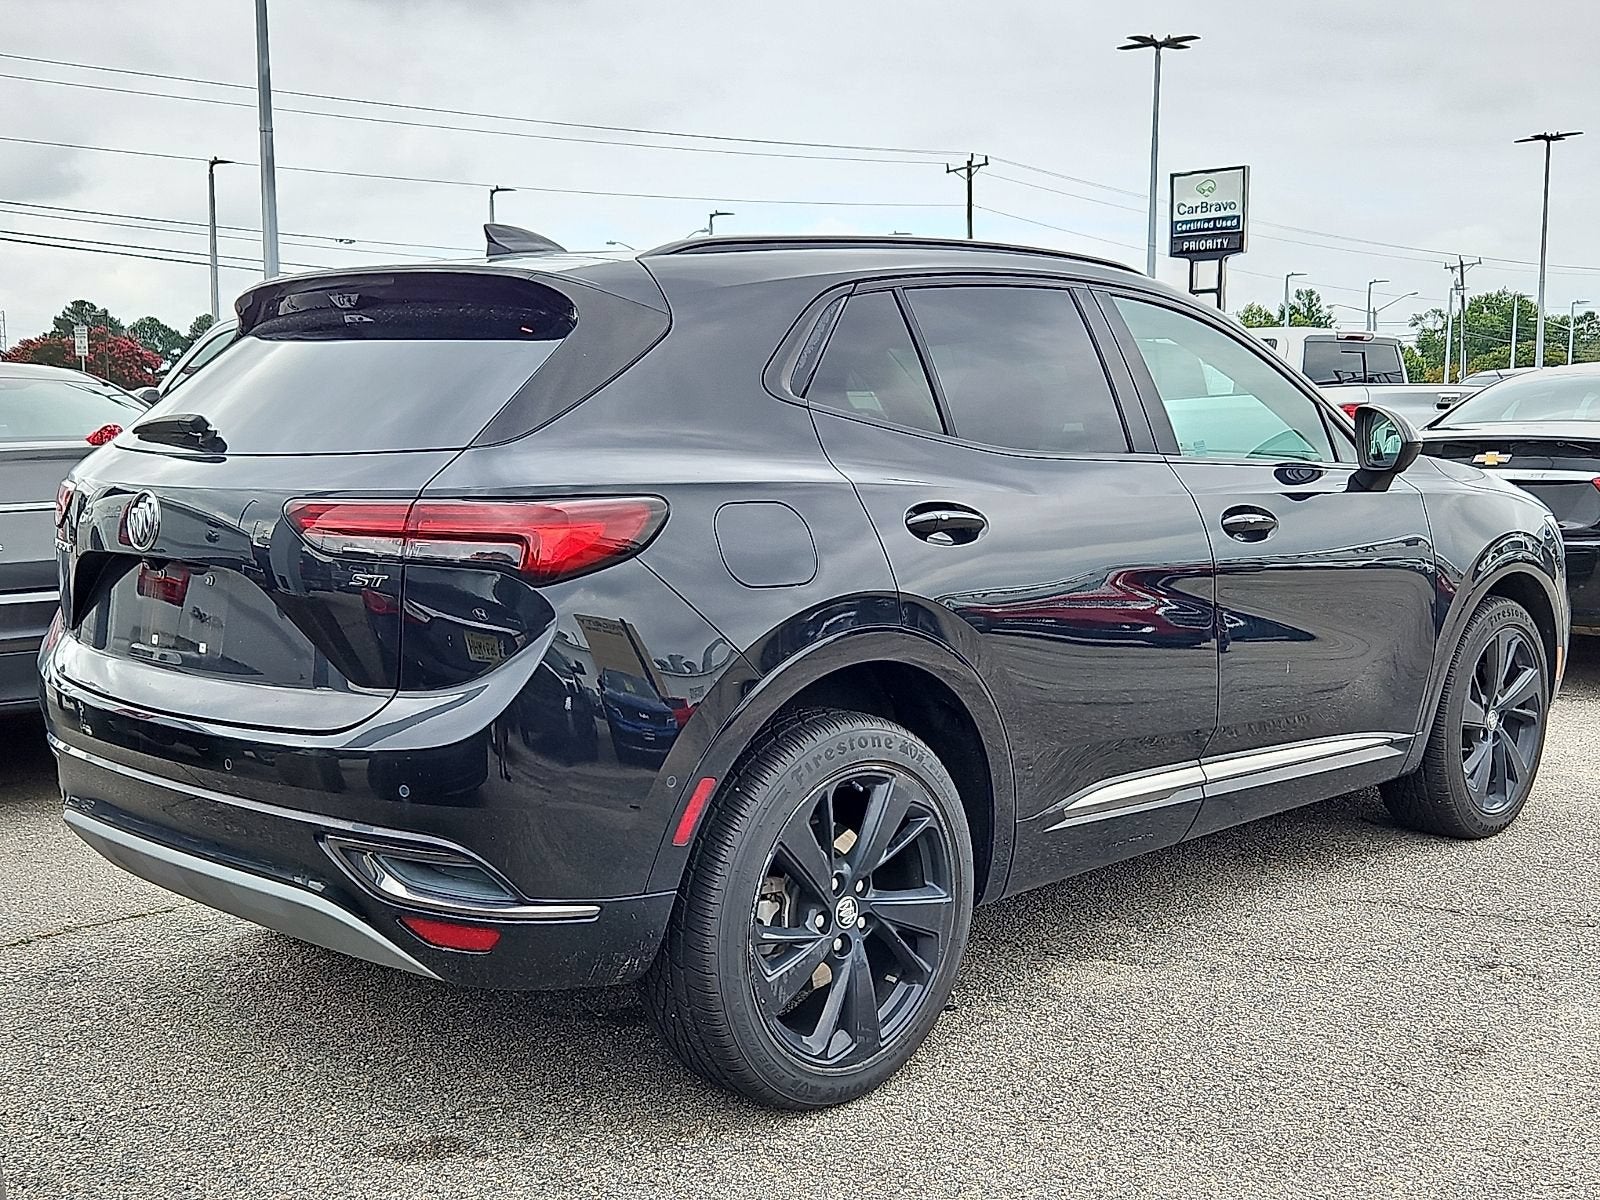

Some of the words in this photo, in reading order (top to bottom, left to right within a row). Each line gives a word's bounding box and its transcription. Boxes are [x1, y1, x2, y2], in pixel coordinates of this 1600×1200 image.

[1177, 201, 1237, 215] CarBravo
[1176, 220, 1213, 231] Certified
[1216, 218, 1238, 228] Used
[1183, 238, 1229, 251] PRIORITY
[349, 573, 389, 588] ST
[1488, 608, 1529, 627] Firestone
[791, 734, 894, 785] Firestone
